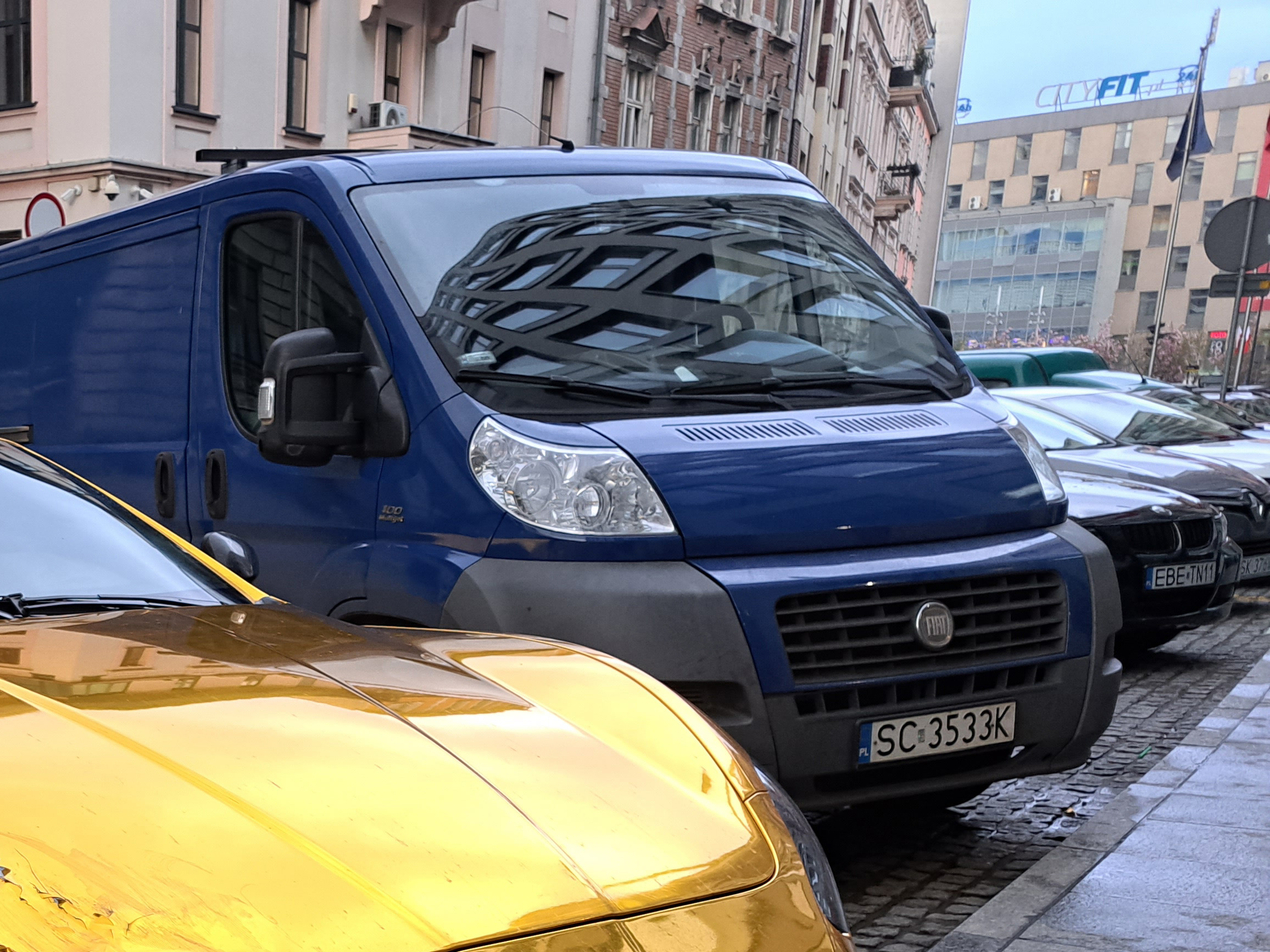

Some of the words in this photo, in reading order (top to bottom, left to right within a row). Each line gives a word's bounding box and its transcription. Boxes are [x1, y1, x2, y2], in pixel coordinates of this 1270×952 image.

[1155, 567, 1186, 587] EBE
[925, 615, 947, 636] FIAT
[859, 747, 870, 757] PL
[877, 721, 917, 756] SC
[928, 705, 1011, 749] 3533K
